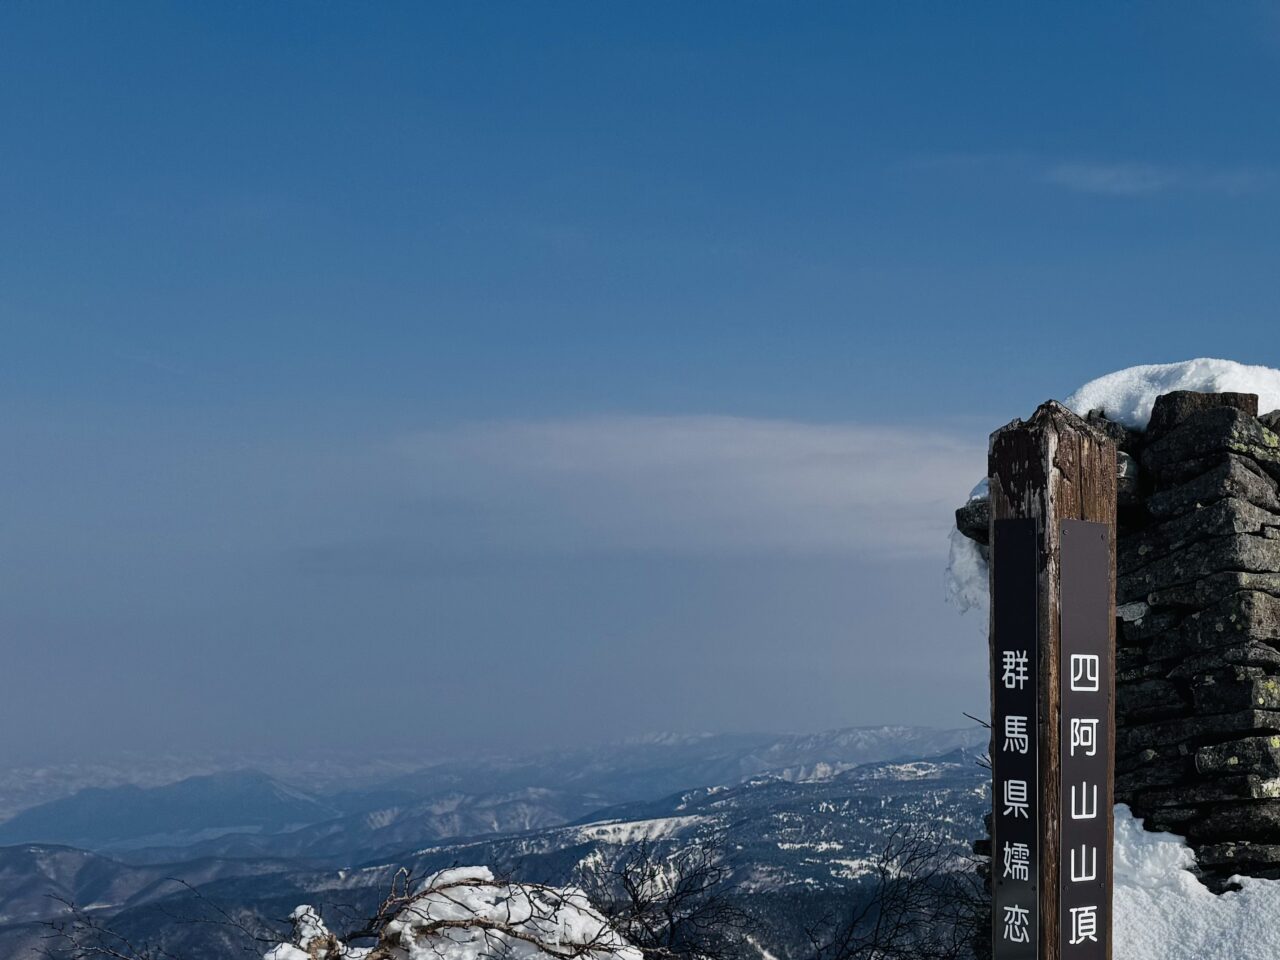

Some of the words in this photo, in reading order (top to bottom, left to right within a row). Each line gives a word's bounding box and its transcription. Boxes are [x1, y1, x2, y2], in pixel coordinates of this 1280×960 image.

[1068, 653, 1100, 945] 四阿山山頂
